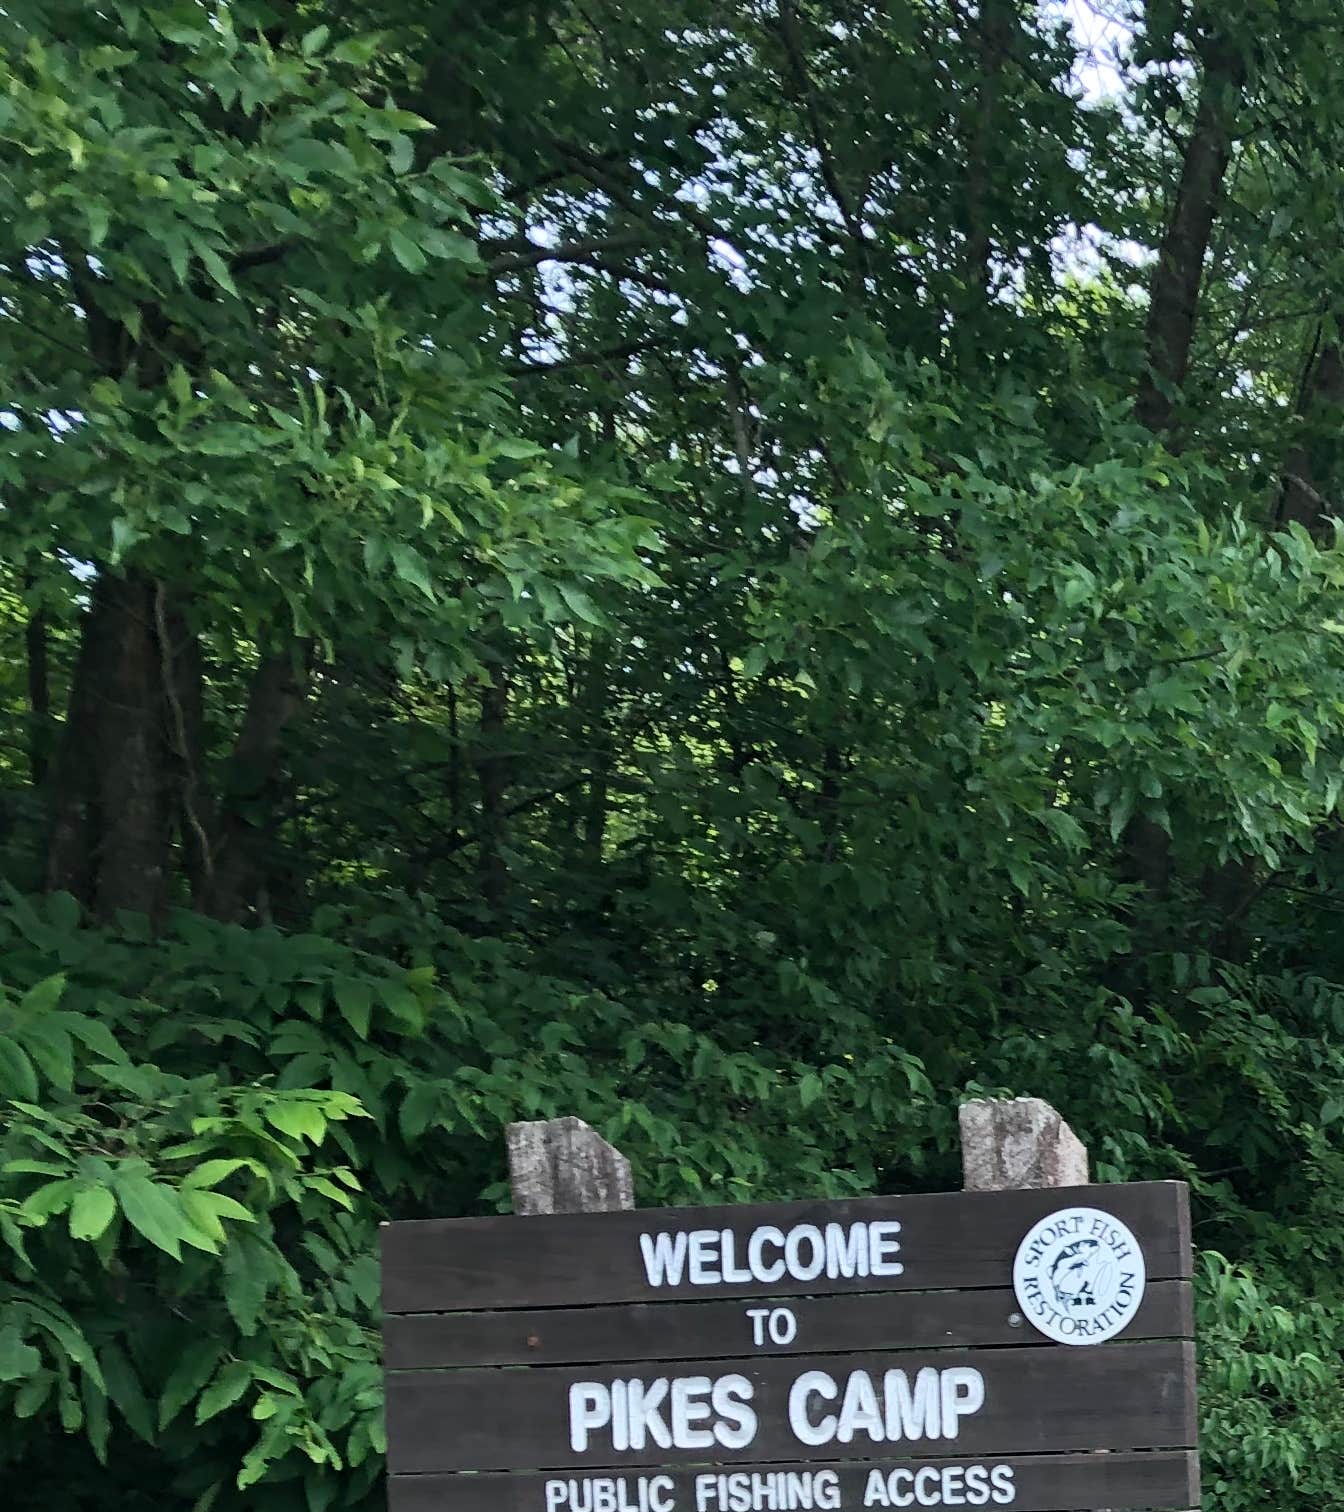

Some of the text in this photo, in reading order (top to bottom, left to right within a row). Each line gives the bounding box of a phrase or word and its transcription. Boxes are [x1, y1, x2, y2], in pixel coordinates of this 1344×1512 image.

[640, 1221, 904, 1287] WELCOME
[1024, 1216, 1132, 1268] SPORT FISH
[746, 1307, 797, 1346] TO
[1023, 1270, 1136, 1337] RESTORATION
[569, 1366, 985, 1453] PIKES CAMP
[695, 1469, 842, 1512] FISHING
[863, 1464, 1016, 1507] ACCESS
